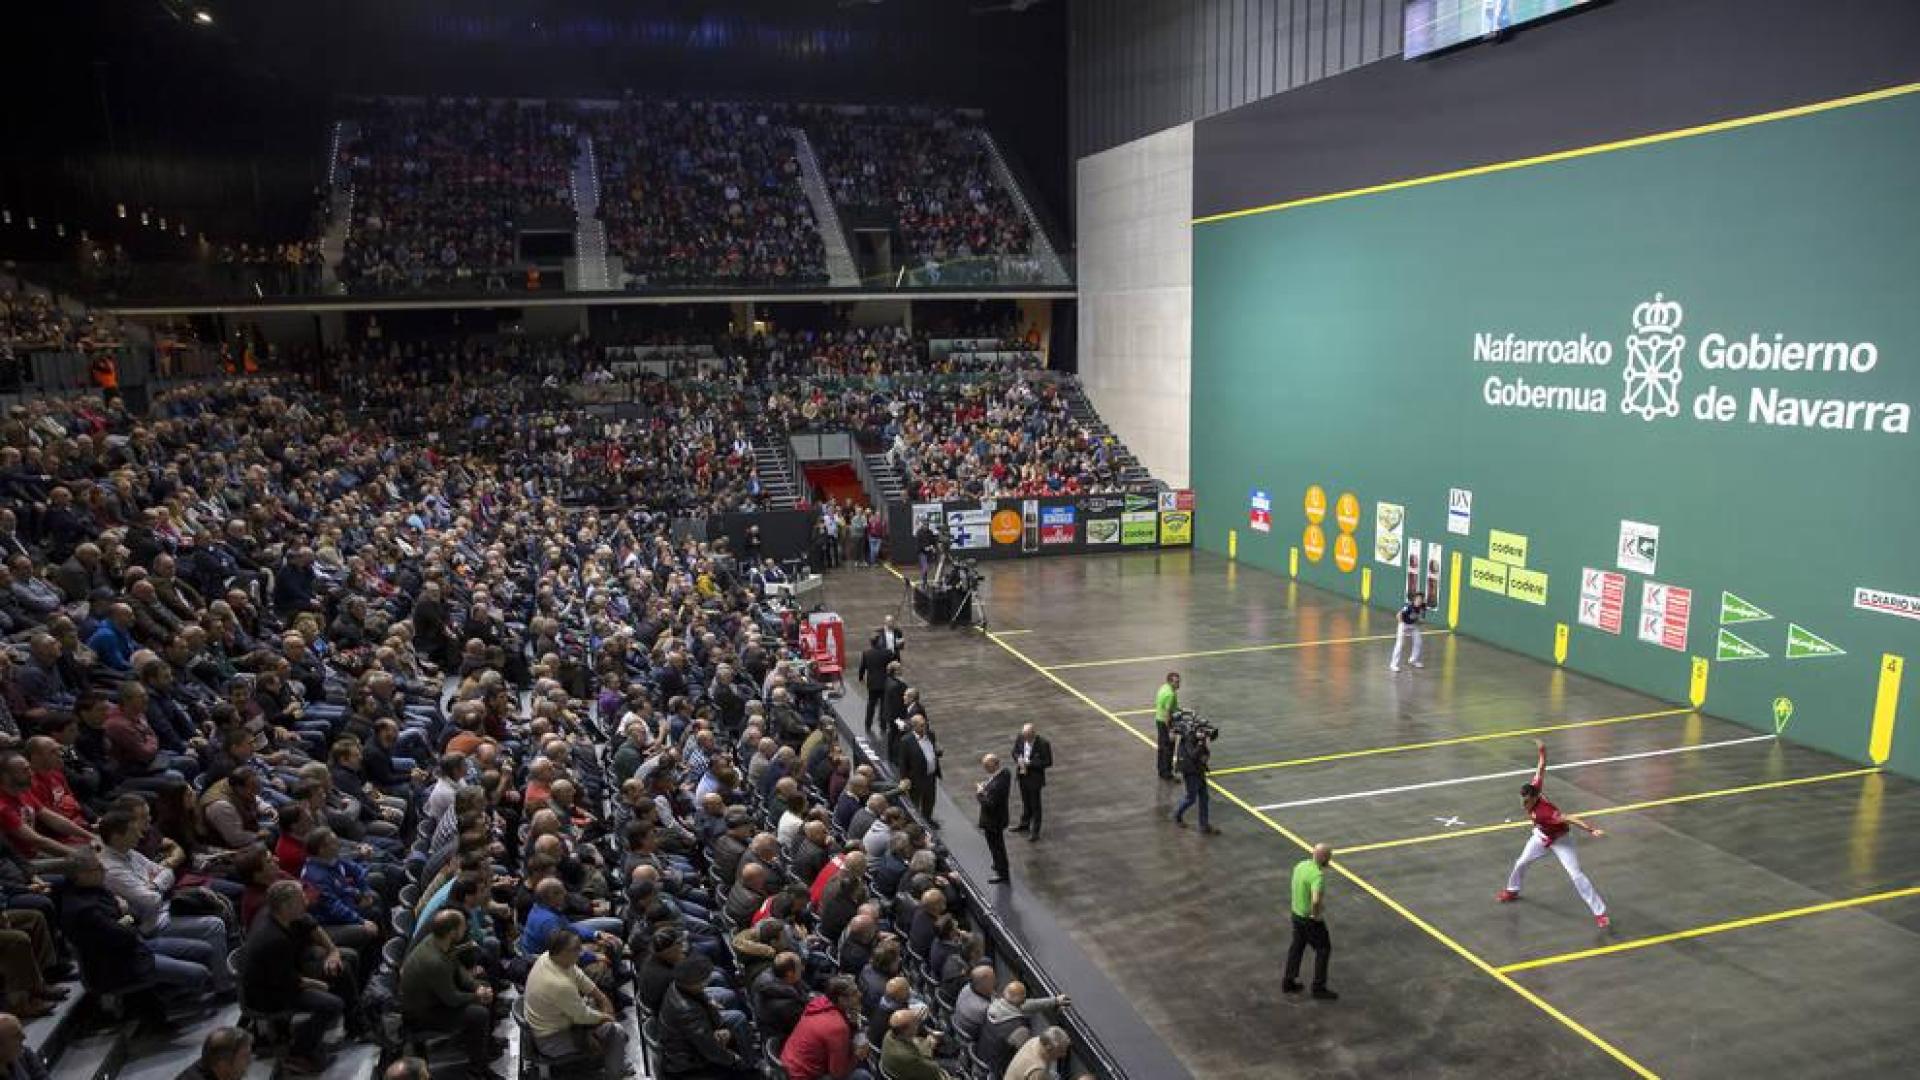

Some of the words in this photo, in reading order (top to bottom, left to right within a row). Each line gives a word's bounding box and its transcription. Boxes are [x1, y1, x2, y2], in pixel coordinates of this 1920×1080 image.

[1473, 333, 1613, 365] Nafarroako
[1699, 333, 1878, 372] Gobierno
[1483, 377, 1607, 412] Gobernua
[1693, 386, 1737, 421] de
[1749, 388, 1911, 433] Navarra
[1492, 542, 1523, 557] codere
[1473, 569, 1503, 584] codere
[1510, 579, 1544, 595] codere
